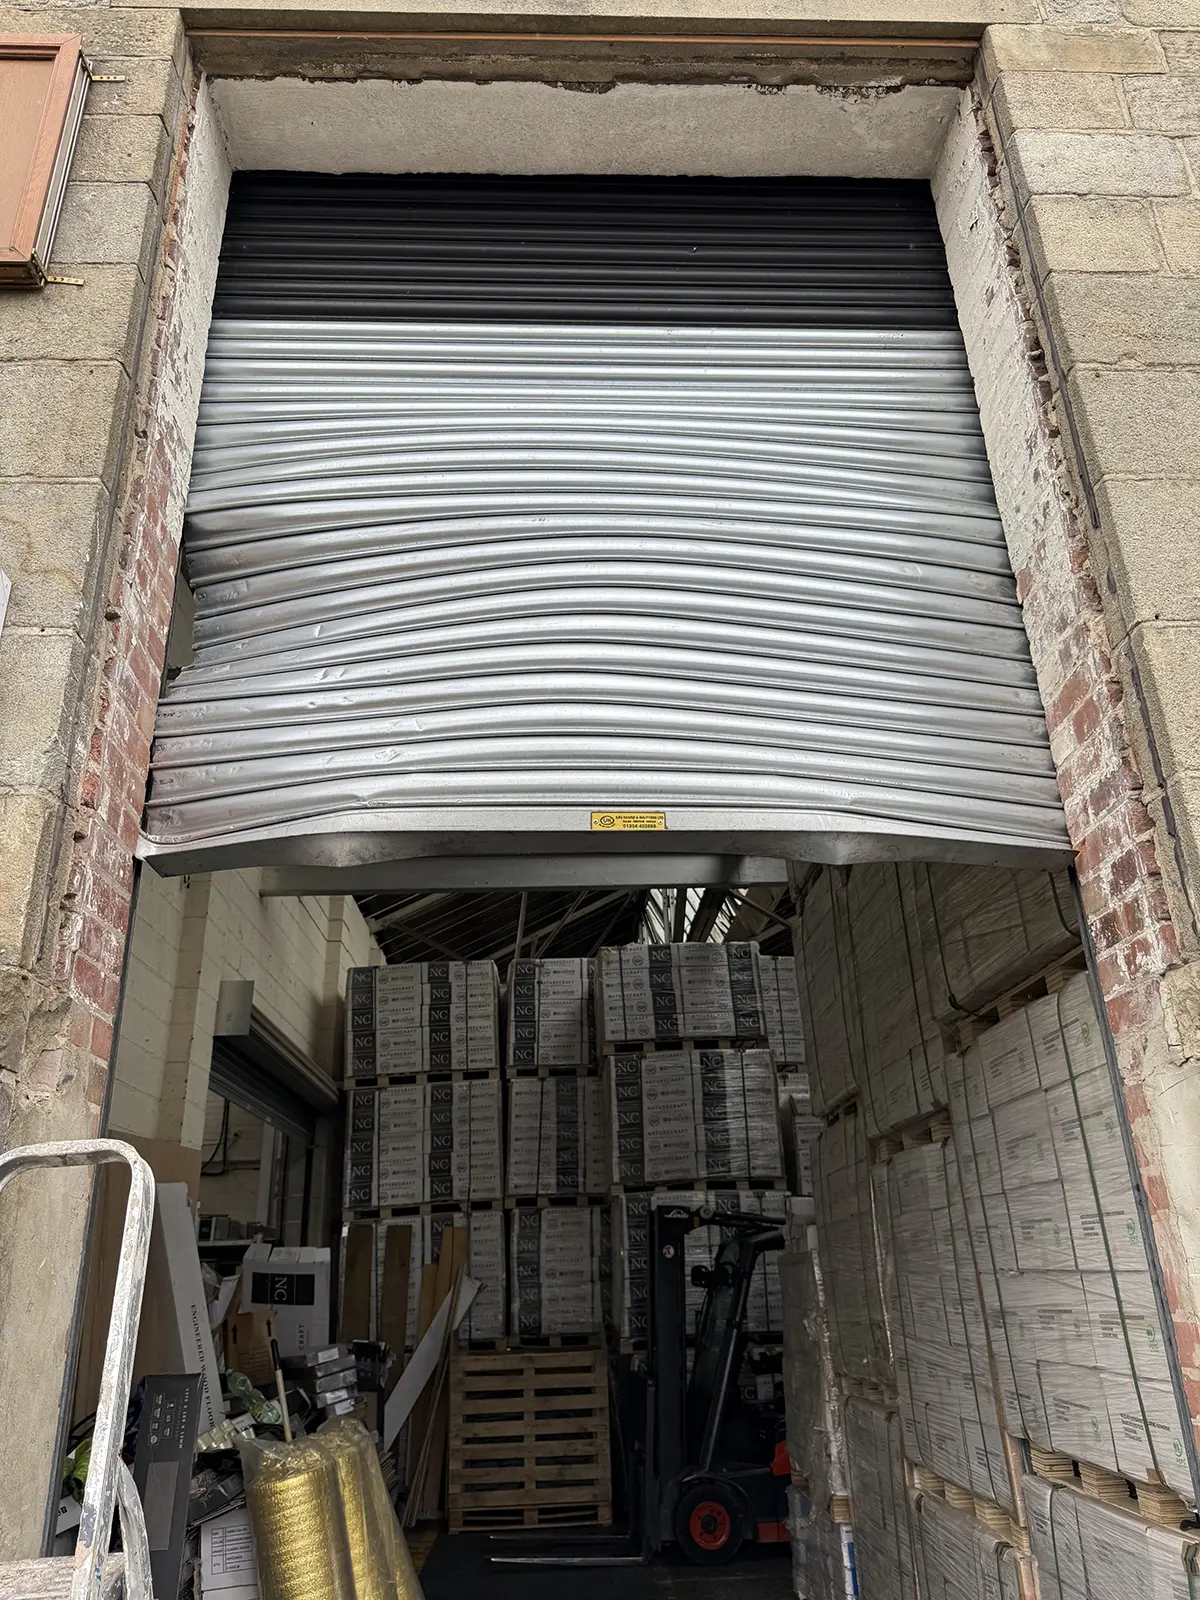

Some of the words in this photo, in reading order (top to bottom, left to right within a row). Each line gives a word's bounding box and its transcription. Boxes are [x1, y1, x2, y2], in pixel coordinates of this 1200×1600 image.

[652, 950, 670, 960] NC
[732, 949, 750, 958] NC
[430, 968, 447, 978] NC
[517, 964, 533, 974] NC
[354, 973, 371, 983] NC
[653, 974, 670, 983] NC
[432, 989, 449, 998] NC
[516, 986, 532, 994] NC
[354, 994, 371, 1003] NC
[656, 997, 674, 1006] NC
[737, 995, 754, 1004] NC
[431, 1010, 448, 1020] NC
[516, 1006, 532, 1015] NC
[354, 1015, 371, 1025] NC
[659, 1020, 677, 1029] NC
[741, 1017, 759, 1027] NC
[432, 1032, 449, 1042] NC
[517, 1029, 534, 1038] NC
[355, 1037, 372, 1047] NC
[432, 1054, 449, 1064] NC
[516, 1050, 532, 1059] NC
[355, 1059, 372, 1069] NC
[702, 1057, 720, 1066] NC
[618, 1062, 636, 1072] NC
[705, 1081, 721, 1090] NC
[433, 1090, 450, 1100] NC
[618, 1087, 636, 1097] NC
[355, 1096, 372, 1105] NC
[705, 1107, 724, 1116] NC
[432, 1113, 449, 1122] NC
[620, 1112, 639, 1124] NC
[354, 1119, 372, 1128] NC
[433, 1136, 450, 1146] NC
[708, 1132, 726, 1142] NC
[353, 1142, 370, 1152] NC
[621, 1139, 639, 1149] NC
[431, 1160, 448, 1169] NC
[709, 1160, 725, 1169] NC
[353, 1166, 370, 1176] NC
[622, 1164, 640, 1176] NC
[433, 1184, 450, 1194] NC
[352, 1190, 369, 1200] NC
[629, 1203, 648, 1214] NC
[521, 1215, 539, 1226] NC
[520, 1240, 537, 1250] NC
[520, 1264, 537, 1276] NC
[274, 1276, 288, 1301] NC
[522, 1289, 537, 1299] NC
[521, 1316, 537, 1327] NC
[191, 1304, 204, 1362] ENGINEERED
